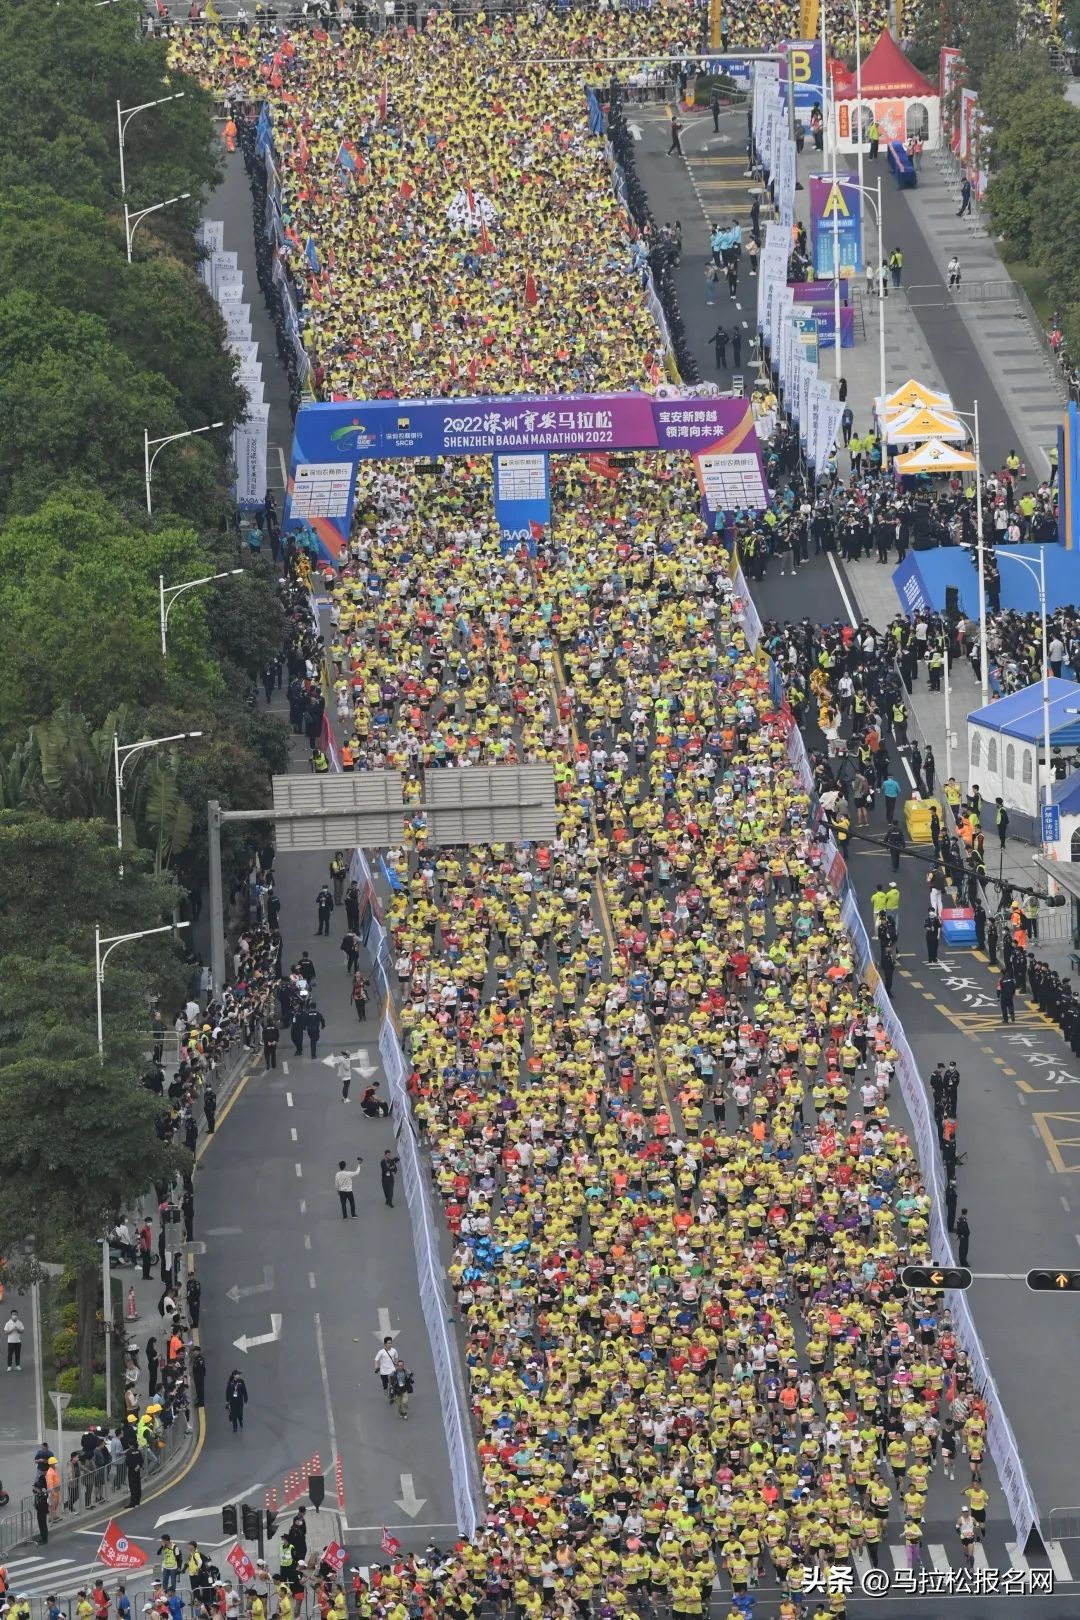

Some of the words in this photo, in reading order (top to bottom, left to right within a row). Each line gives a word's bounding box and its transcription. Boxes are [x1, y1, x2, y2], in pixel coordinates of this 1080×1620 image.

[791, 50, 812, 82] B
[822, 181, 850, 218] A
[659, 410, 718, 423] 宝安新跨越
[443, 435, 495, 448] SHENZHEN
[496, 434, 529, 446] BAOAN
[530, 432, 584, 445] MARATHON
[586, 431, 613, 443] 2022
[665, 425, 724, 438] 领湾向未来
